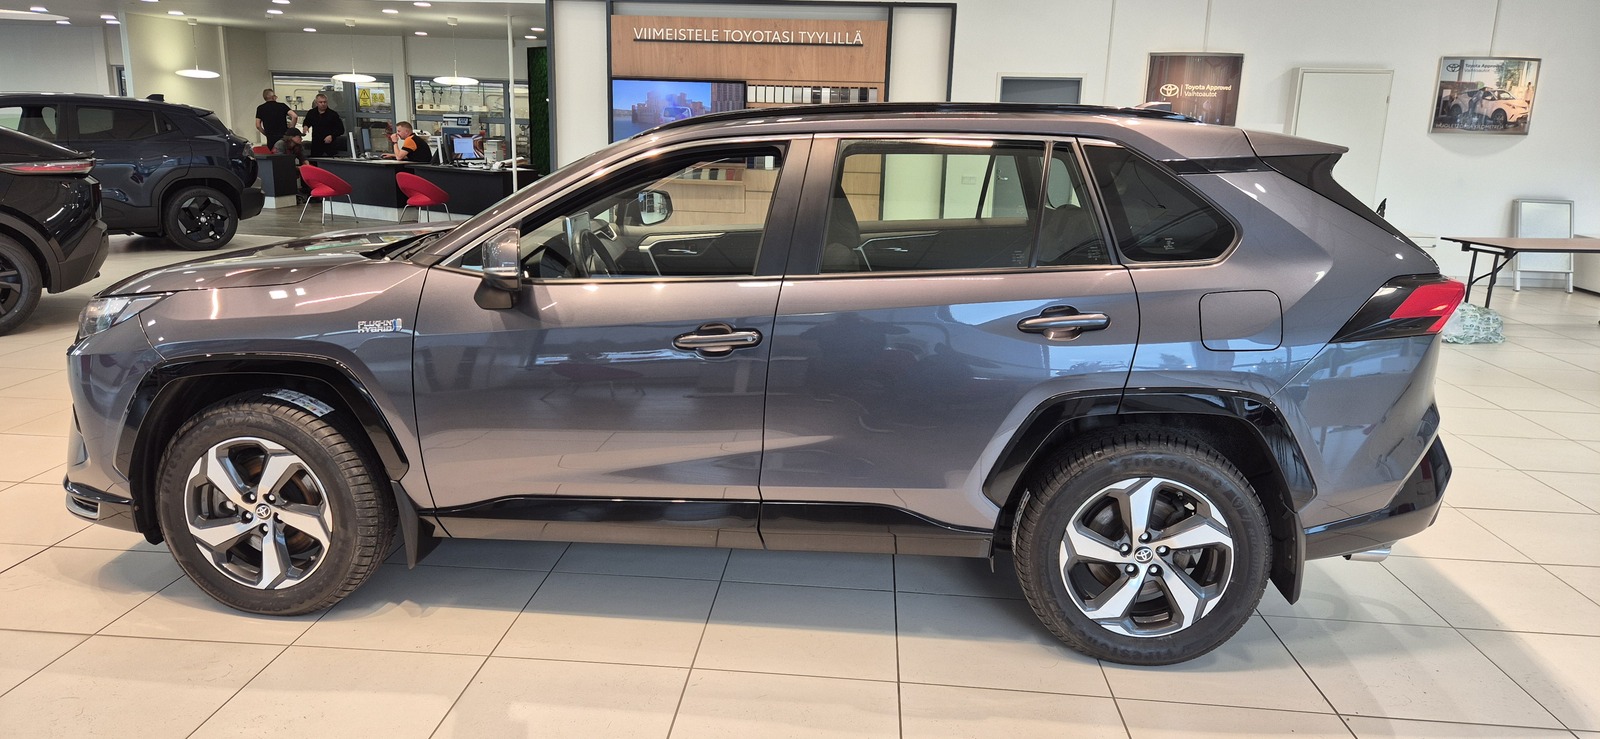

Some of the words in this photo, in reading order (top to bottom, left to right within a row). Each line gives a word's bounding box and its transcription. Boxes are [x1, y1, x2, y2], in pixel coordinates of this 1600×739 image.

[633, 27, 719, 42] VIIMEISTELE
[723, 29, 794, 43] TOYOTASI
[798, 30, 863, 45] TYYLILLÄ
[1205, 84, 1232, 92] Approved
